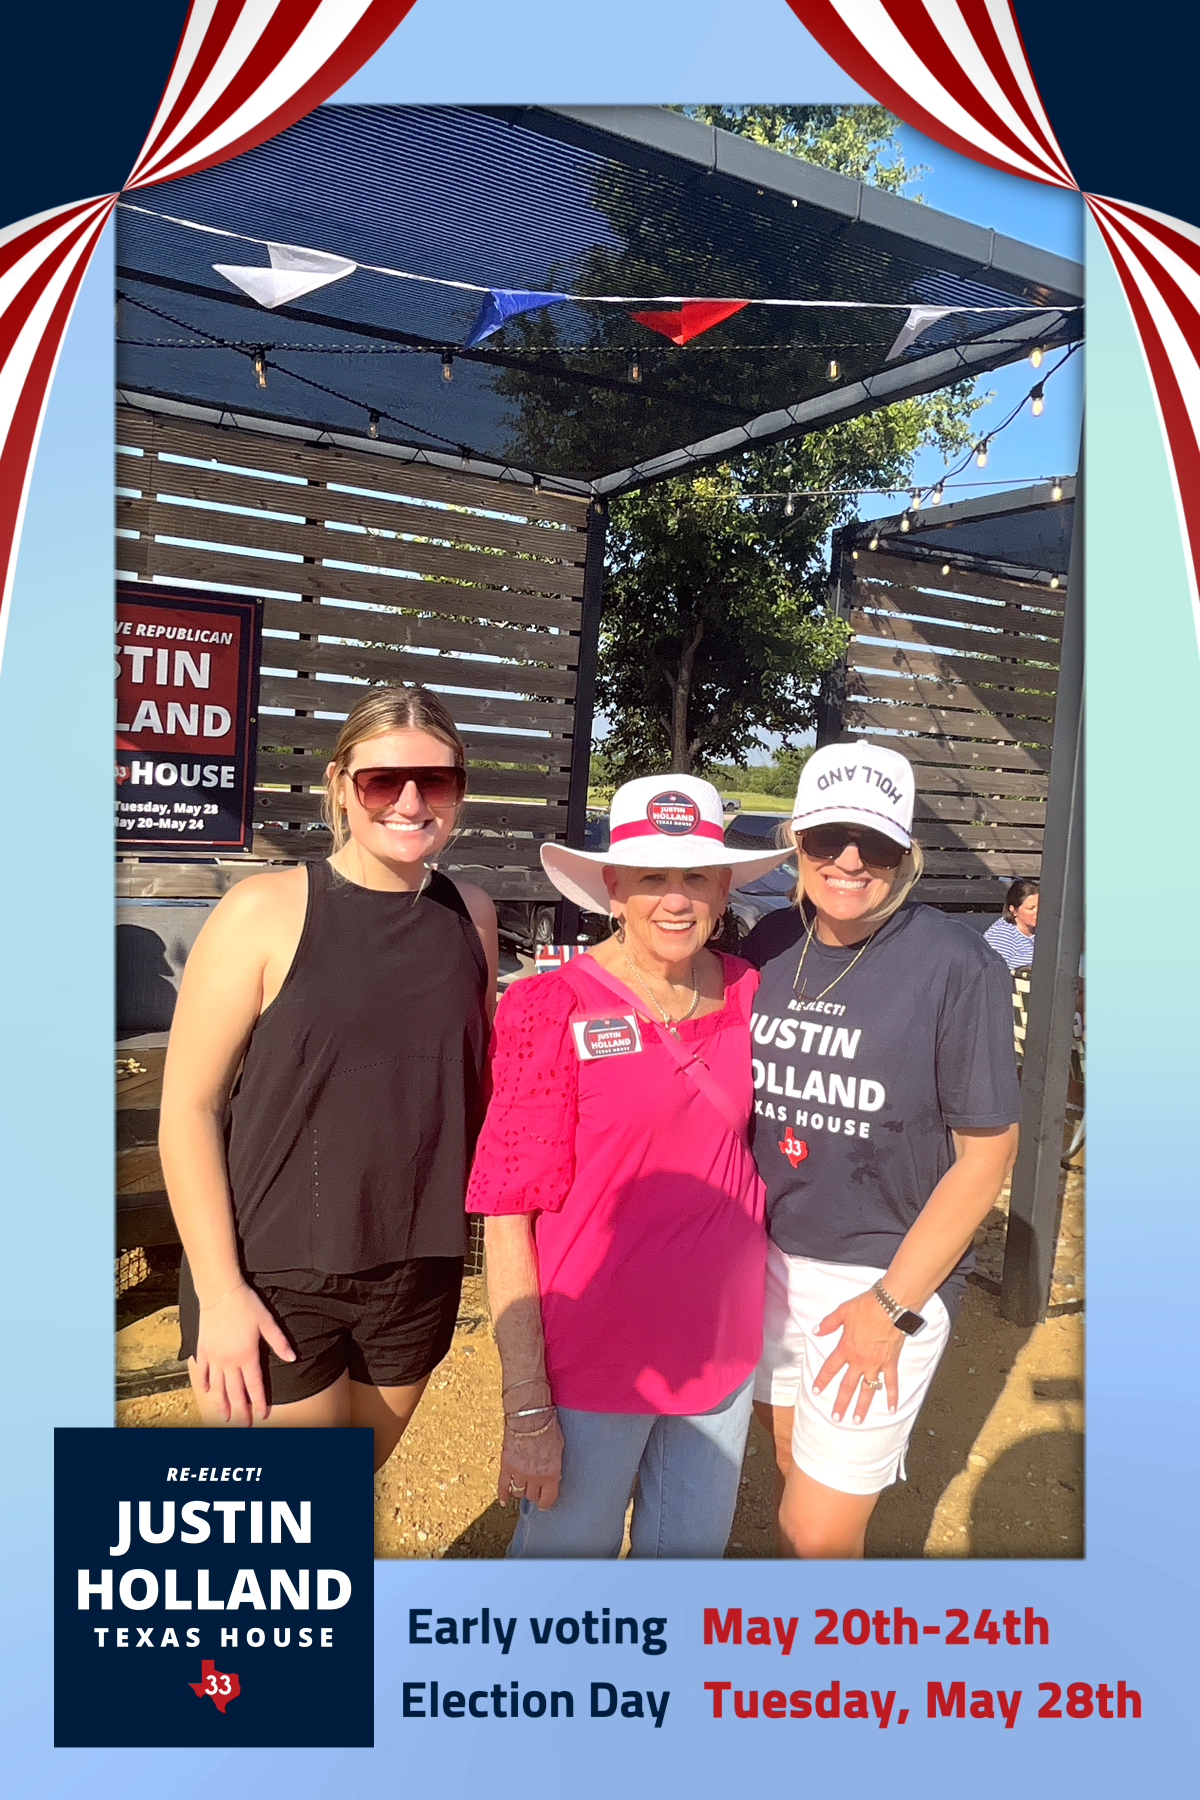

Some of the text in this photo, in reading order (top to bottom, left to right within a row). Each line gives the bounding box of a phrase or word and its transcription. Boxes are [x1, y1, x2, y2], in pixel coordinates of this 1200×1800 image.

[135, 623, 233, 645] REPUBLICAN
[131, 760, 235, 789] HOUSE
[817, 765, 903, 805] HOLLAND
[115, 801, 219, 817] Tuesday, May 28
[653, 812, 695, 822] HOLLAND
[660, 806, 686, 814] JUSTIN
[188, 819, 205, 830] 24
[591, 1038, 632, 1050] HOLLAND
[597, 1031, 622, 1041] JUSTIN
[796, 1109, 871, 1139] HOUSE
[785, 1138, 802, 1156] 33
